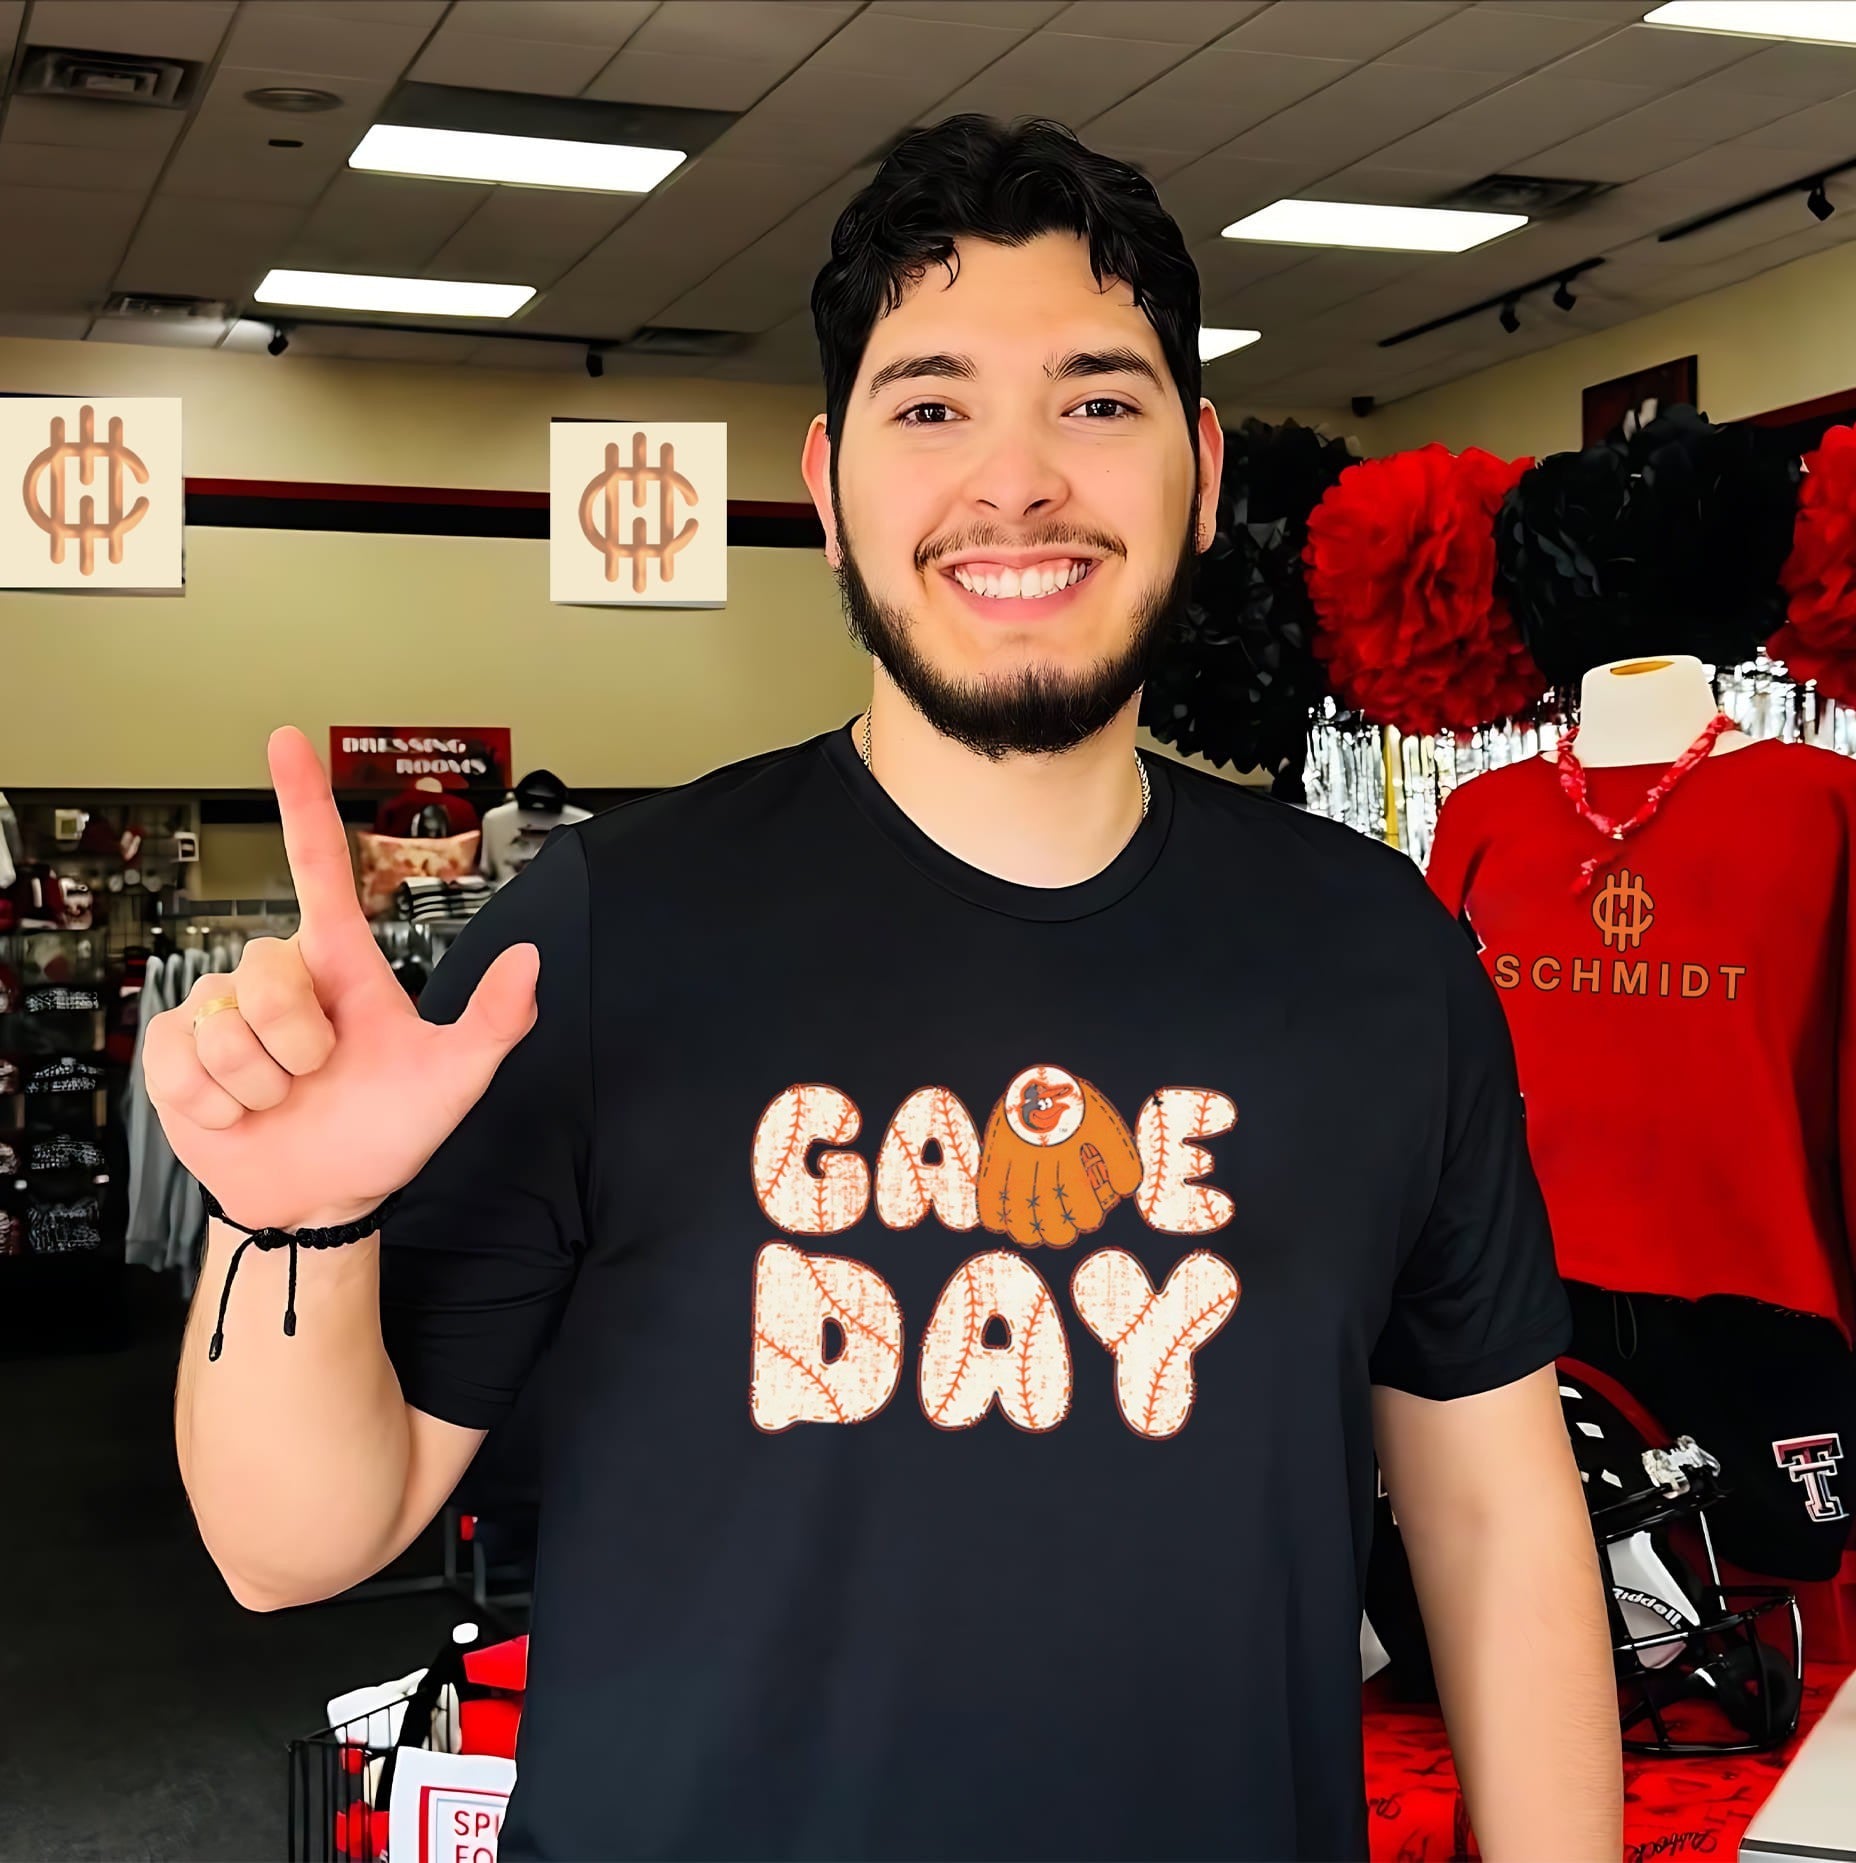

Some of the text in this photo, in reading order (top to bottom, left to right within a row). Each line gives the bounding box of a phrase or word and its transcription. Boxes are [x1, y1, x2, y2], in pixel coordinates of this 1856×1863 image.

[342, 737, 466, 754] DRESSING
[396, 758, 487, 775] ROOMS
[1494, 954, 1746, 1000] SCHMIDT
[751, 1064, 1238, 1248] GAE
[750, 1240, 1242, 1440] DAY
